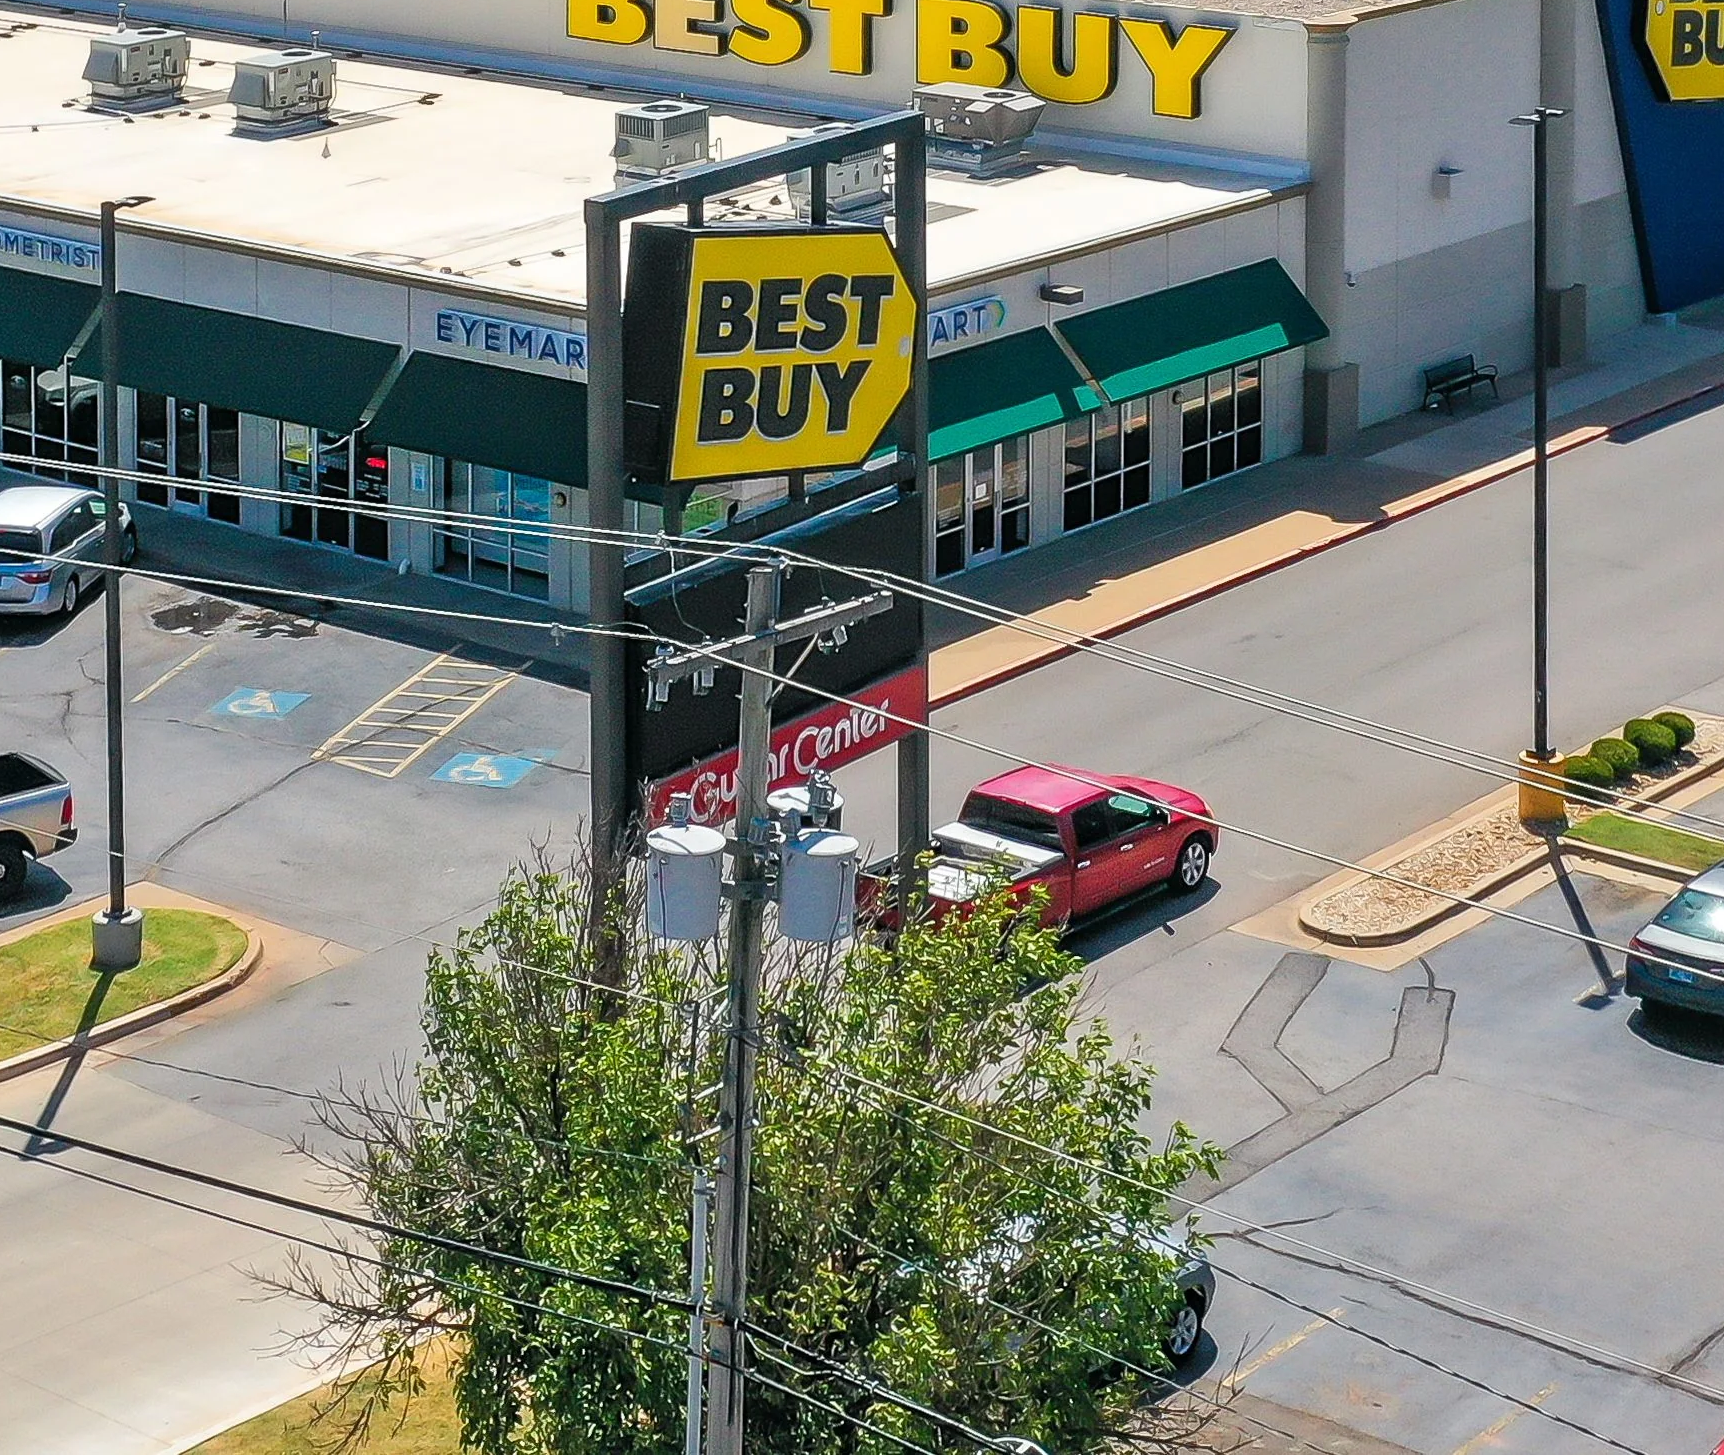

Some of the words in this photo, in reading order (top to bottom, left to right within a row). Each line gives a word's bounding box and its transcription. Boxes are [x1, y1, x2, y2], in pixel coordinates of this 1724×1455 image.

[436, 310, 587, 369] EYEMAR
[695, 274, 895, 357] BEST
[696, 358, 873, 445] BUY
[793, 697, 889, 776] Center
